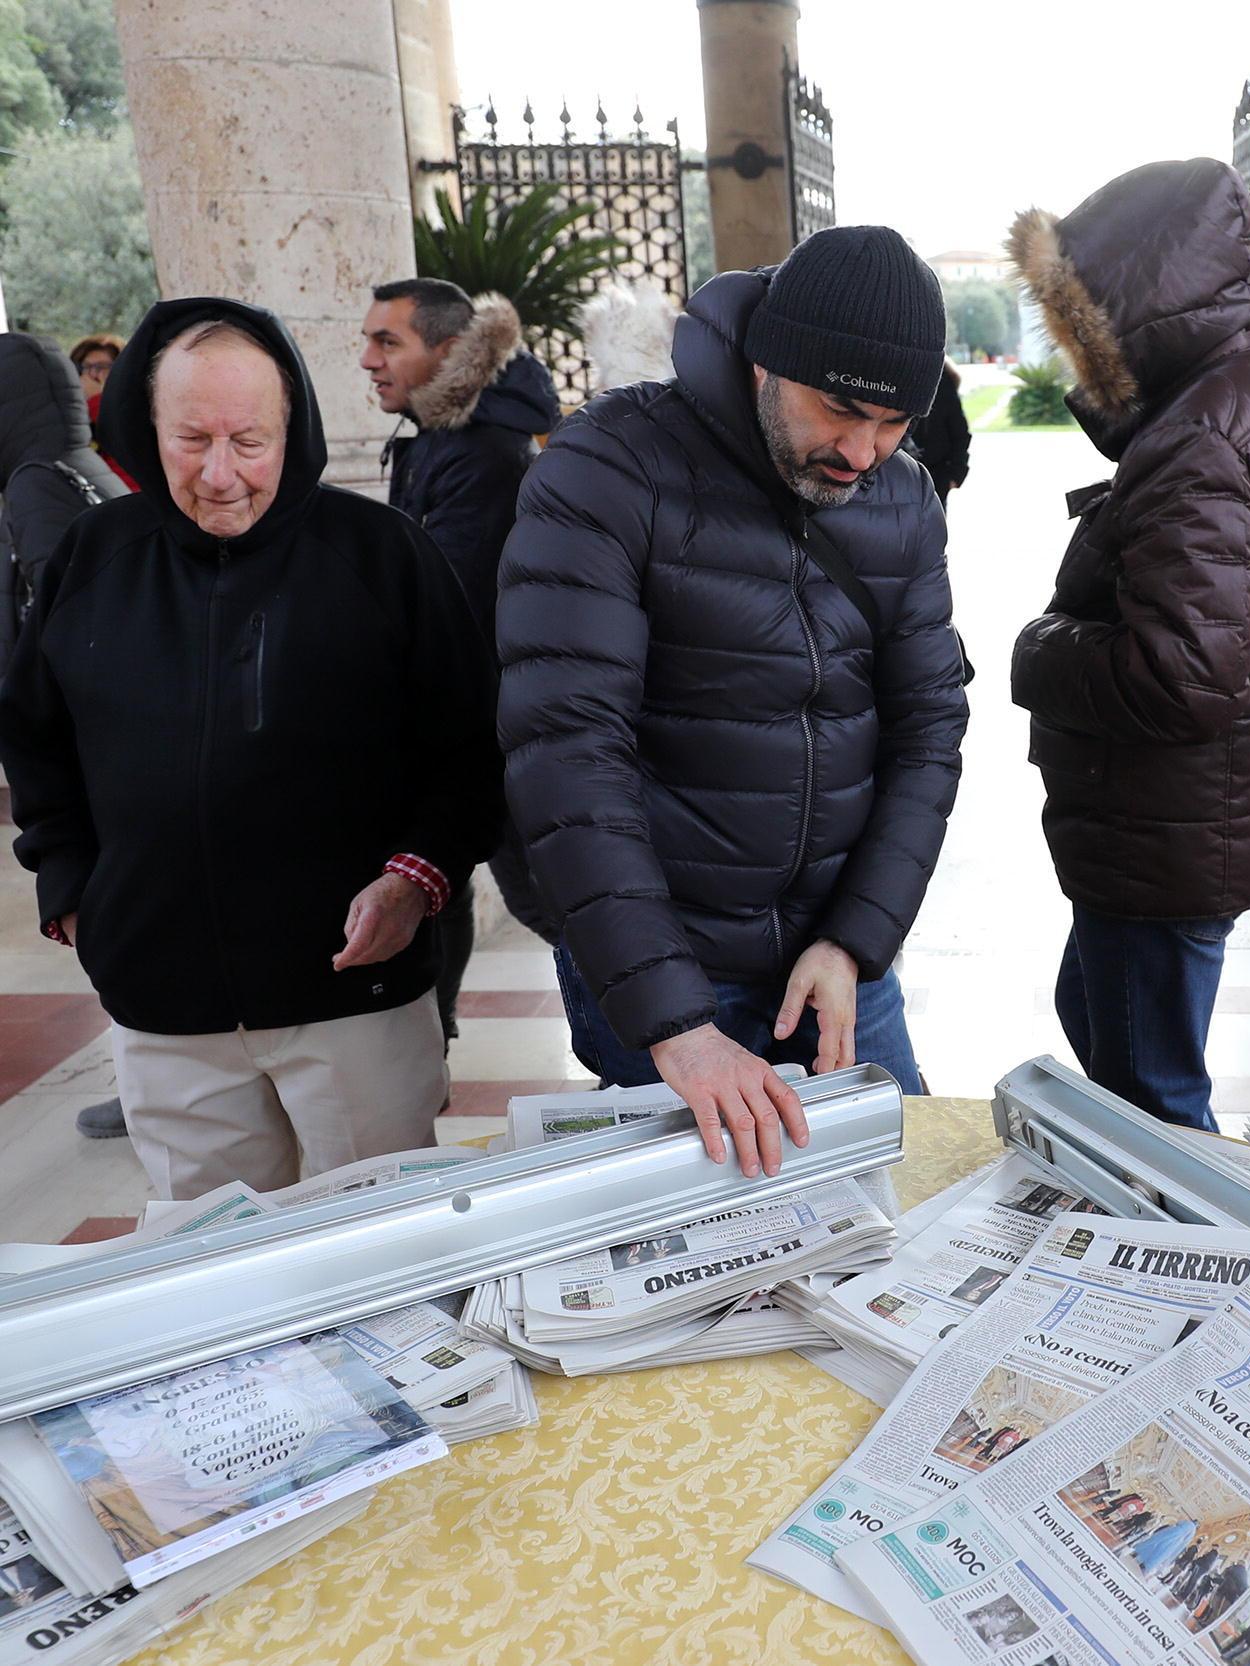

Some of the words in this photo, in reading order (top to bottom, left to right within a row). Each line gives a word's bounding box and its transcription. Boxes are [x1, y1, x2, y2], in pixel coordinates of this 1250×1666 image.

[840, 374, 896, 393] Columbia
[770, 1219, 794, 1227] Prodi
[983, 1219, 1000, 1227] furti
[988, 1207, 1008, 1216] uffici
[712, 1229, 747, 1240] Insieme
[749, 1224, 768, 1232] vota
[1010, 1228, 1038, 1240] Raffica
[774, 1239, 803, 1252] IL
[644, 1250, 774, 1294] TIRRENO
[1108, 1244, 1137, 1270] IL
[1138, 1248, 1250, 1286] TIRRENO
[1184, 1286, 1218, 1294] MONTECATINI
[1079, 1310, 1104, 1323] lancia
[1106, 1318, 1147, 1335] Gentiloni
[1080, 1300, 1104, 1312] Prodi
[1104, 1304, 1124, 1317] vota
[1124, 1311, 1159, 1325] Insieme
[1022, 1328, 1062, 1353] «No
[1059, 1342, 1074, 1357] a
[1074, 1352, 1132, 1376] centri
[1066, 1320, 1089, 1331] «Con
[1088, 1324, 1100, 1335] te
[1100, 1328, 1122, 1340] Italia
[1121, 1337, 1137, 1345] più
[1138, 1340, 1166, 1352] forte»
[1012, 1342, 1058, 1364] L'assessore
[1071, 1365, 1100, 1379] divieto
[132, 1355, 265, 1412] INGRESSO
[1031, 1370, 1056, 1384] apertura
[1217, 1365, 1250, 1389] VERSO
[165, 1398, 206, 1418] 0-17
[215, 1378, 258, 1400] anni
[188, 1402, 230, 1422] over
[236, 1389, 264, 1404] 65:
[1189, 1381, 1230, 1423] «No
[1218, 1404, 1238, 1430] a
[185, 1401, 267, 1436] Gratuito
[244, 1409, 293, 1434] anni:
[1177, 1395, 1216, 1432] L'assessore
[1212, 1426, 1228, 1444] sul
[1224, 1434, 1250, 1460] divieto
[192, 1421, 299, 1466] Contributo
[202, 1432, 305, 1475] Volontario
[1156, 1415, 1178, 1435] Domenica
[1182, 1436, 1202, 1456] apertura
[1207, 1456, 1229, 1480] Tettuccio,
[1230, 1478, 1242, 1491] visite
[921, 1464, 958, 1490] Trova
[850, 1510, 883, 1532] MO
[870, 1504, 886, 1514] 0574
[1034, 1501, 1065, 1538] Trova
[972, 1532, 985, 1546] 0574
[983, 1545, 1001, 1564] 611029
[1056, 1529, 1080, 1552] la
[947, 1538, 985, 1576] MOC
[1070, 1545, 1108, 1580] moglie
[1047, 1549, 1066, 1566] giovane
[1093, 1594, 1109, 1611] ancora
[1112, 1614, 1129, 1632] braccio
[1132, 1635, 1155, 1660] figlioletta
[1099, 1573, 1145, 1619] morta
[26, 1584, 141, 1651] RENO
[1132, 1606, 1157, 1631] in
[1144, 1618, 1180, 1654] casa
